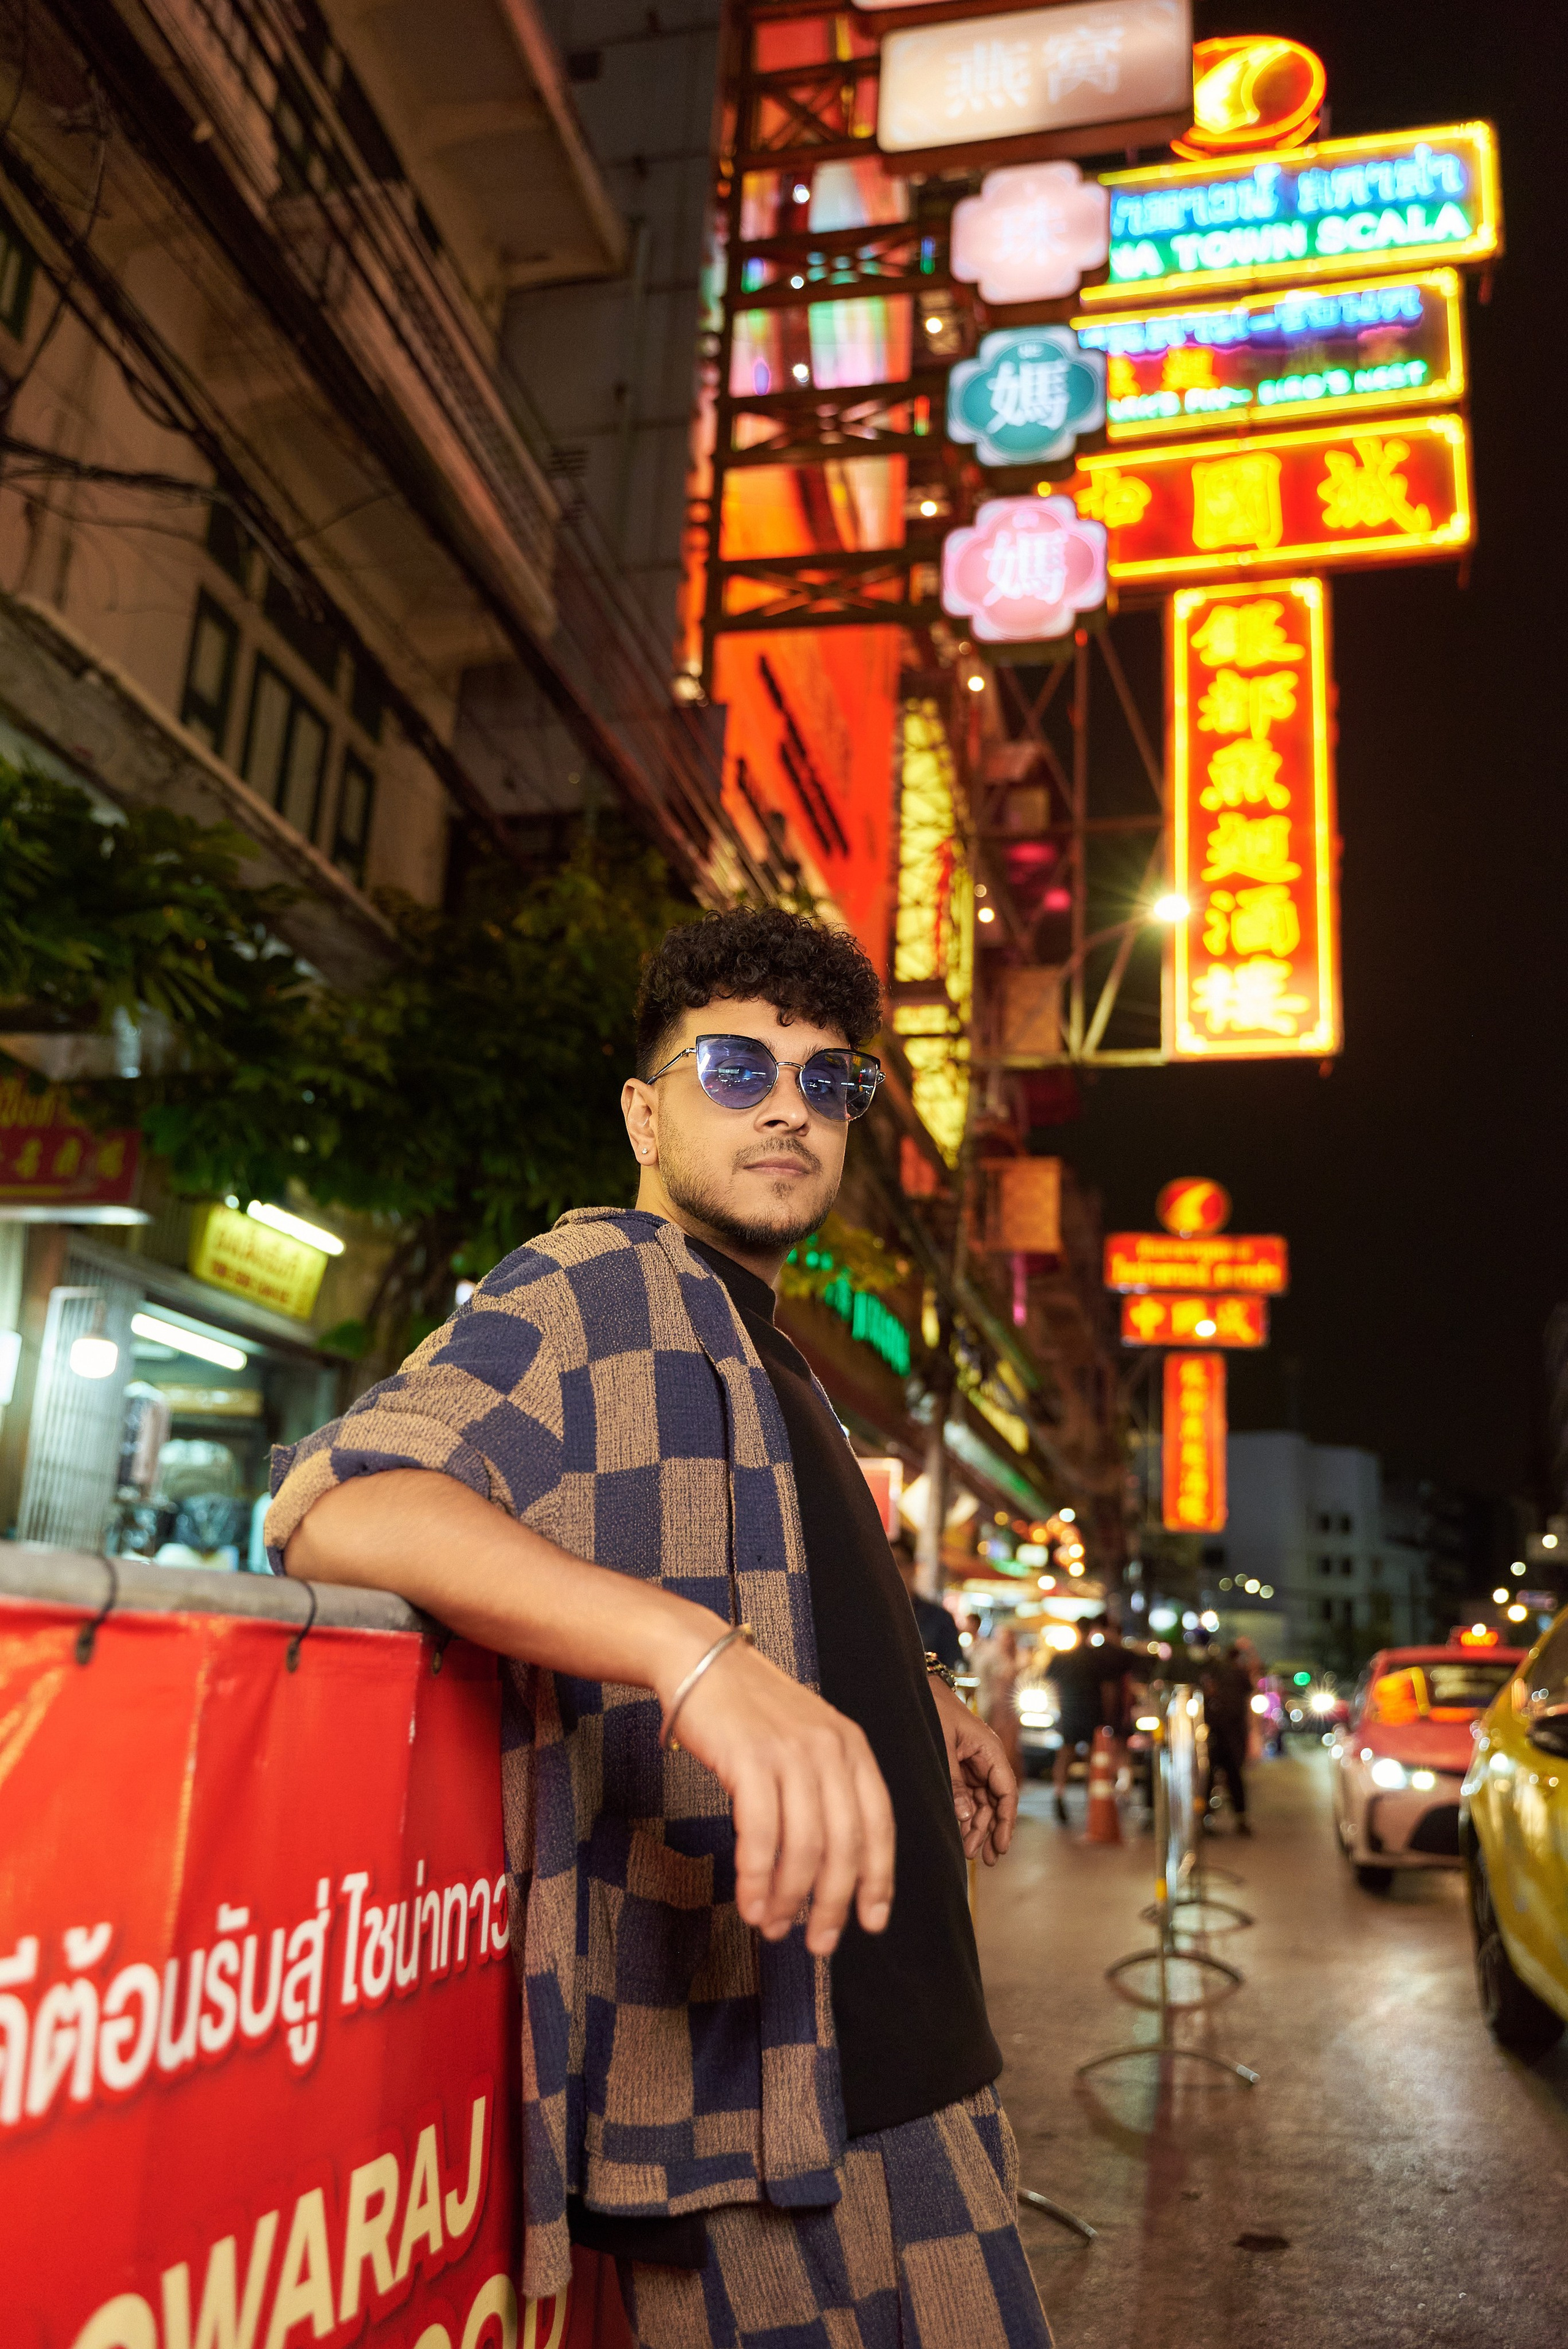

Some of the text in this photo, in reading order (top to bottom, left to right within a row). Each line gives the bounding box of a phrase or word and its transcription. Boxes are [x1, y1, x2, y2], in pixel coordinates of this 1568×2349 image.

[1170, 219, 1308, 271] TOWN
[1316, 201, 1472, 255] SCALA
[986, 358, 1070, 434] 媽
[982, 529, 1068, 607] 媽
